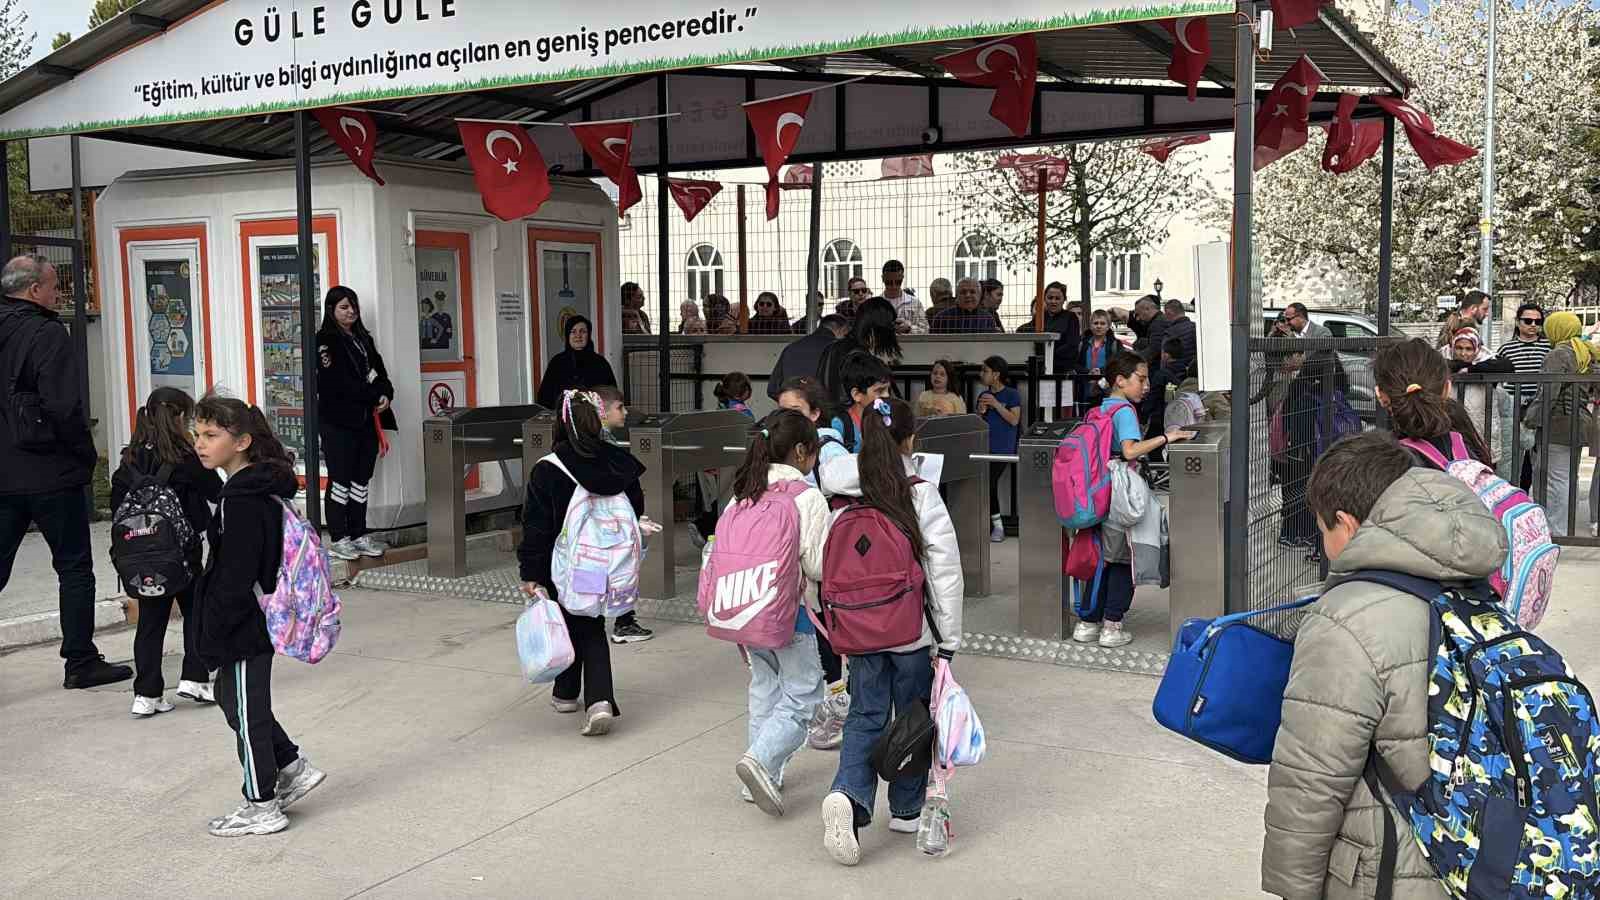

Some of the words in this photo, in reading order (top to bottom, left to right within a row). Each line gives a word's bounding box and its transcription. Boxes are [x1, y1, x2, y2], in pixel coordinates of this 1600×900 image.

[234, 6, 326, 46] GÜLE
[201, 74, 251, 96] kültür
[254, 72, 275, 89] ve
[278, 61, 317, 90] bilgi
[320, 50, 432, 86] aydınlığına
[436, 42, 500, 73] açılan
[504, 39, 531, 58] en
[536, 26, 599, 62] geniş
[714, 559, 778, 613] NIKE
